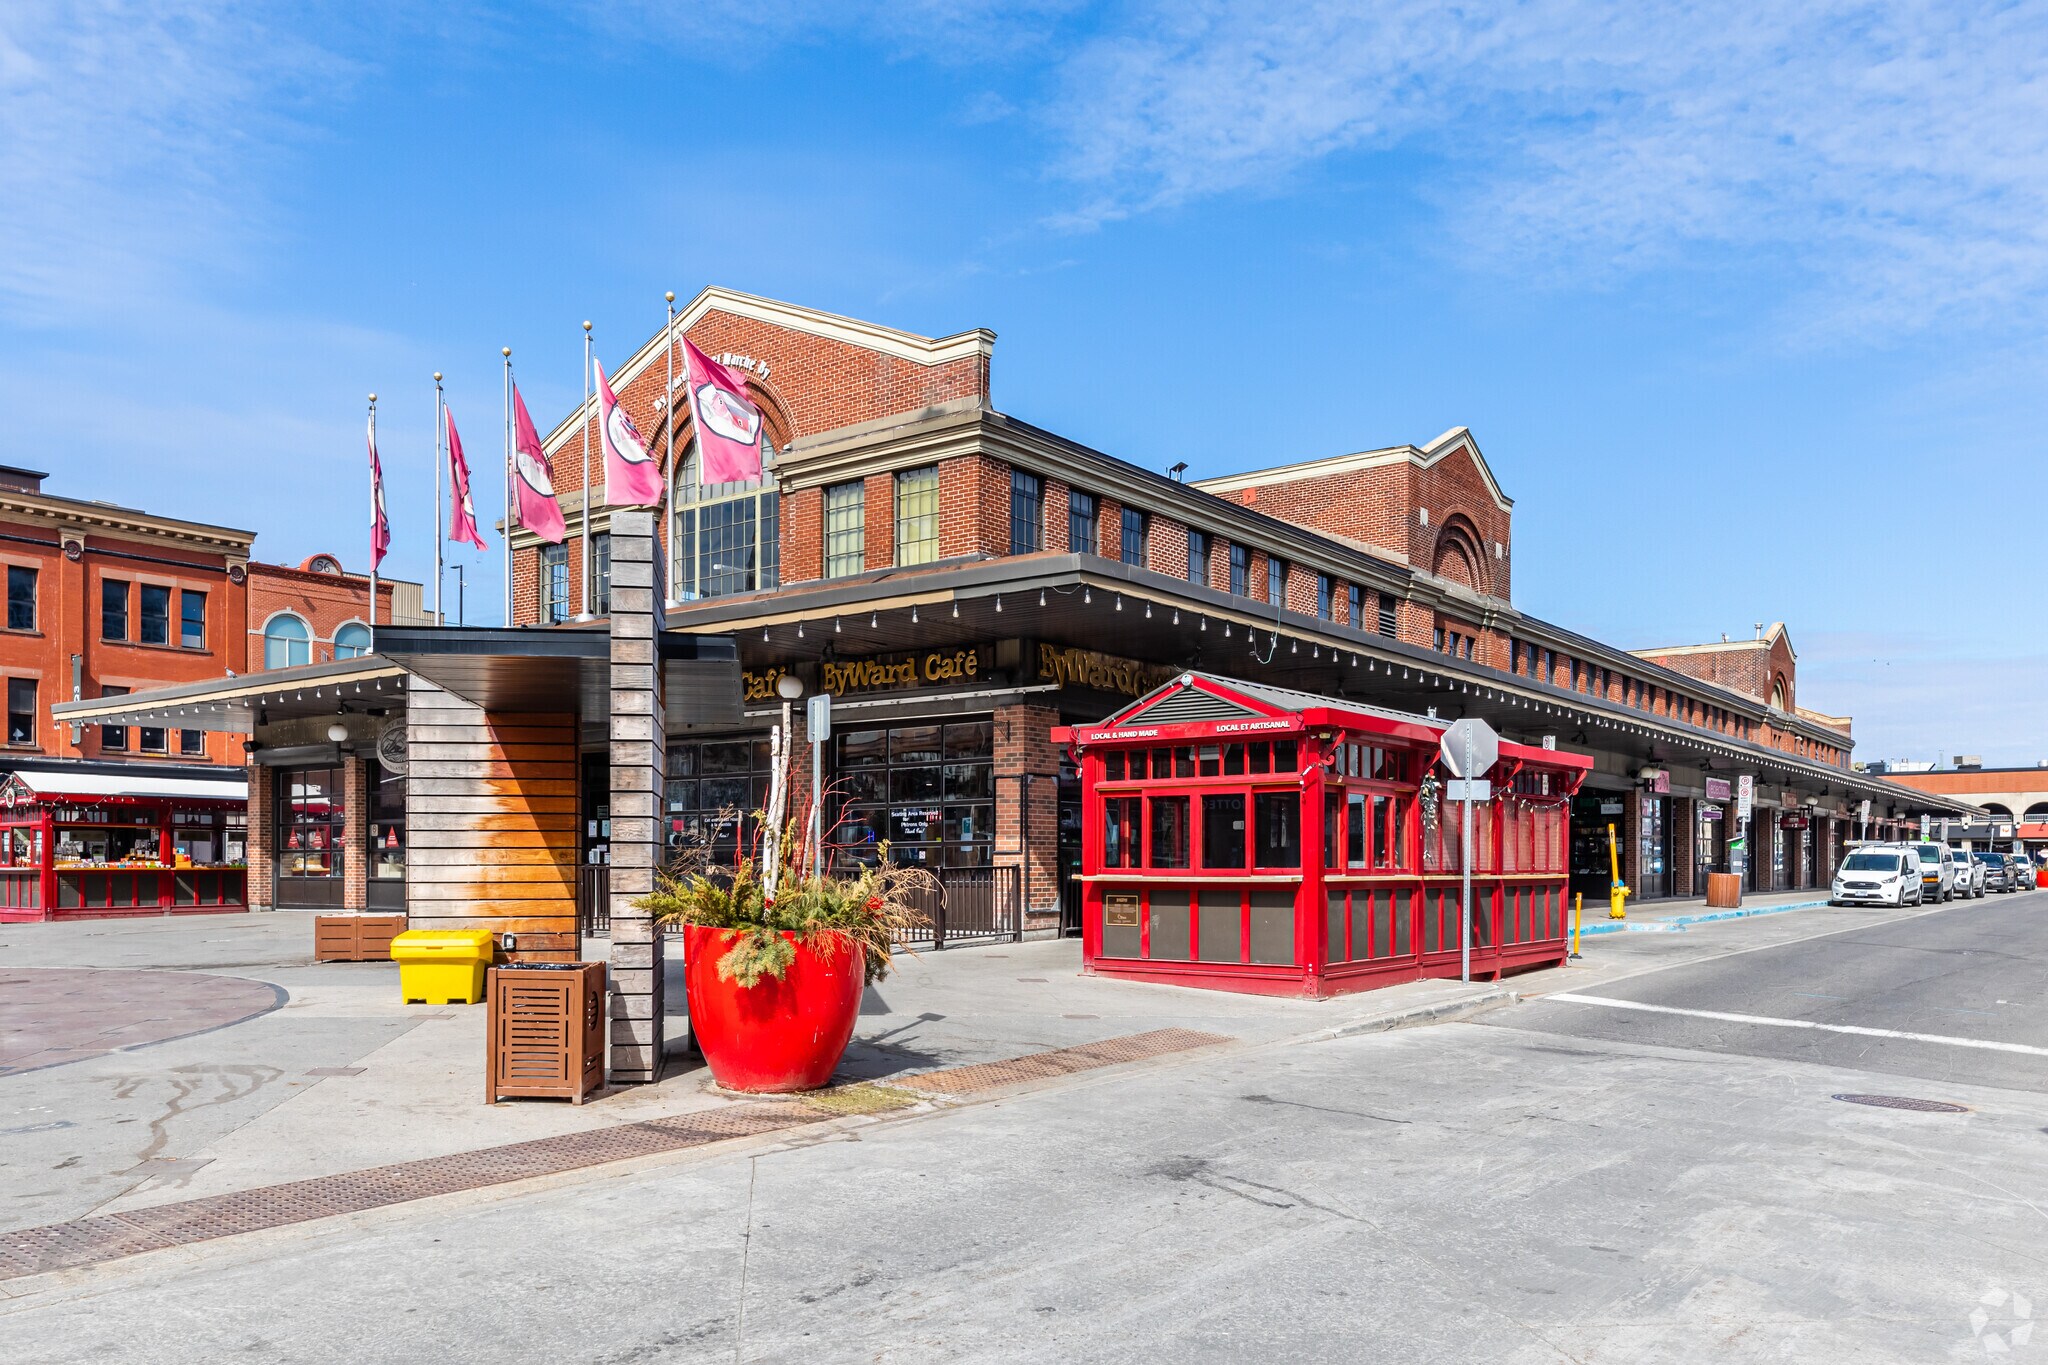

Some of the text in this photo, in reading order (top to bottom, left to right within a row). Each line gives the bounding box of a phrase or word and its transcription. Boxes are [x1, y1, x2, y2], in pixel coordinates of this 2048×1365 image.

[758, 360, 771, 381] By
[317, 561, 330, 573] 56
[824, 650, 978, 697] ByWard Café
[1040, 643, 1134, 694] ByWard
[1138, 729, 1158, 737] MADE
[1216, 721, 1290, 732] LOCAL ET ARTISANAL
